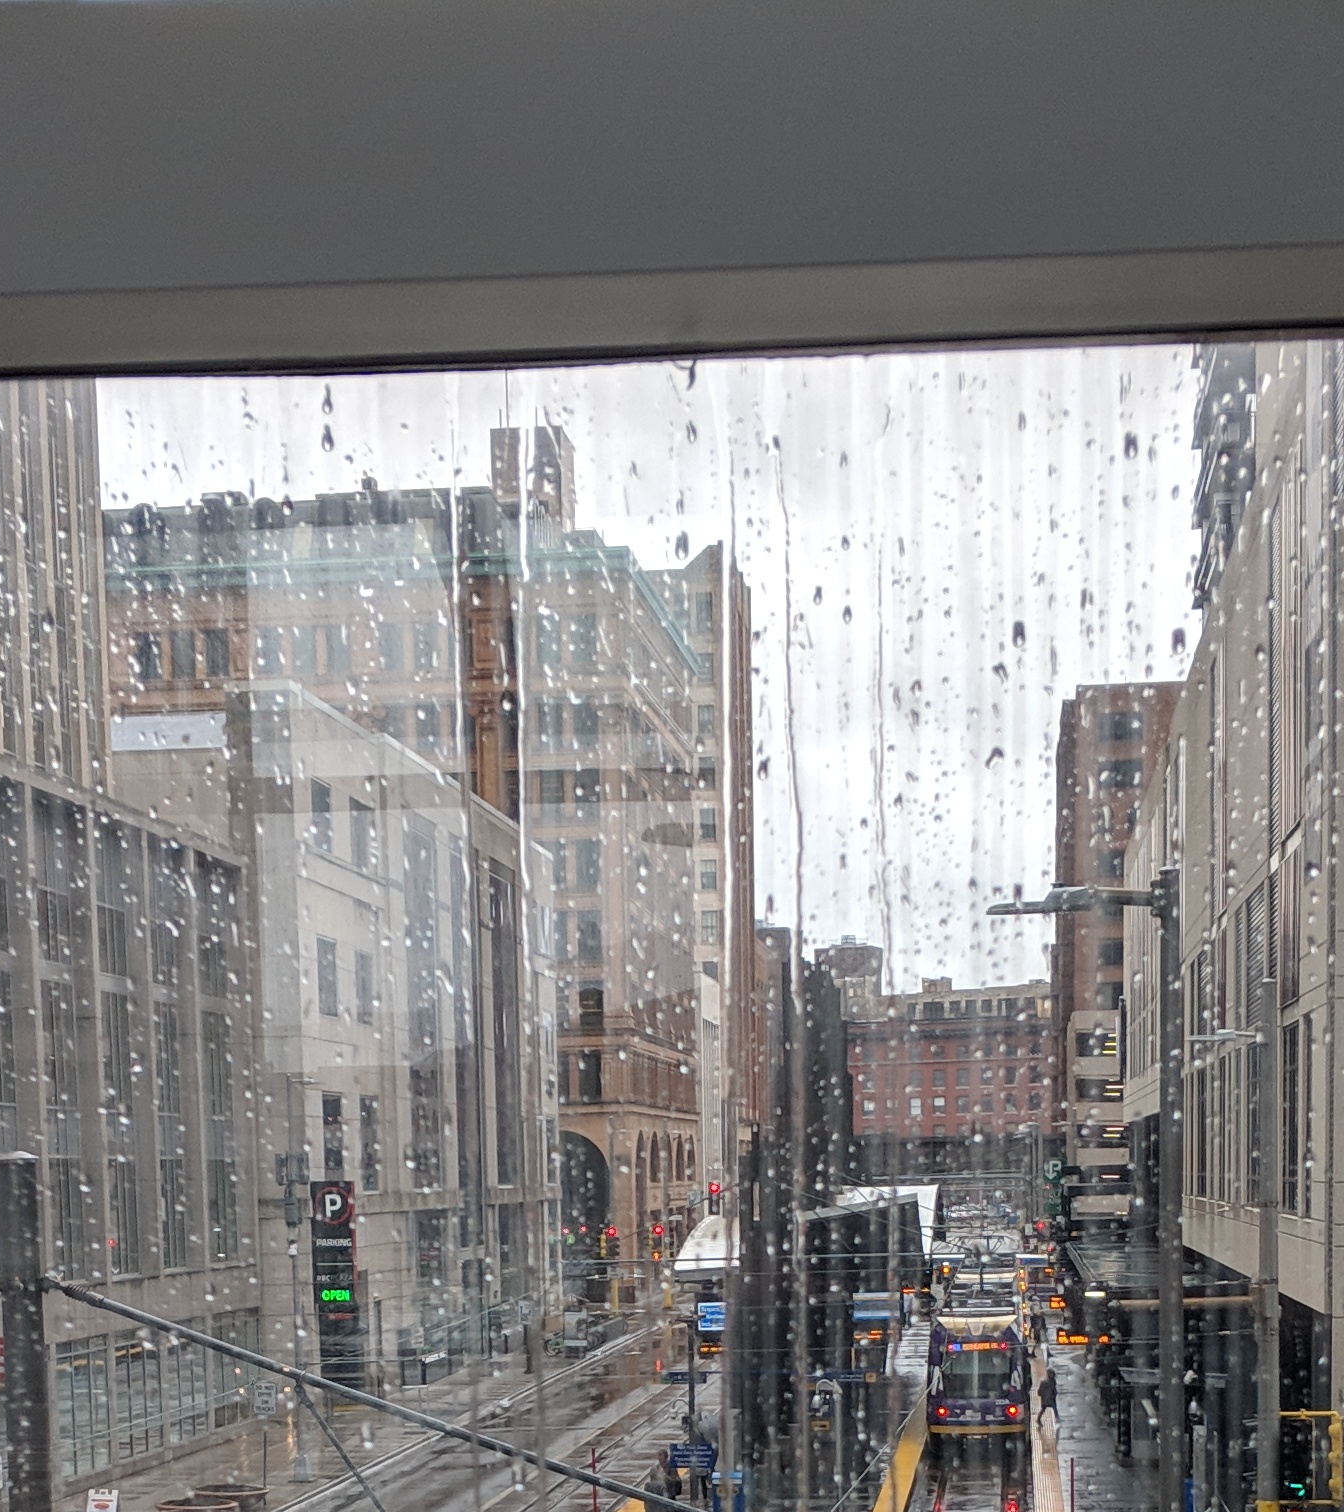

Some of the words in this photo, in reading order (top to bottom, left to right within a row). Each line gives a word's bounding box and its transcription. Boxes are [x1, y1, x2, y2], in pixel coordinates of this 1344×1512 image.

[324, 1193, 342, 1218] P
[316, 1238, 352, 1247] PARKING
[322, 1290, 350, 1301] OPEN
